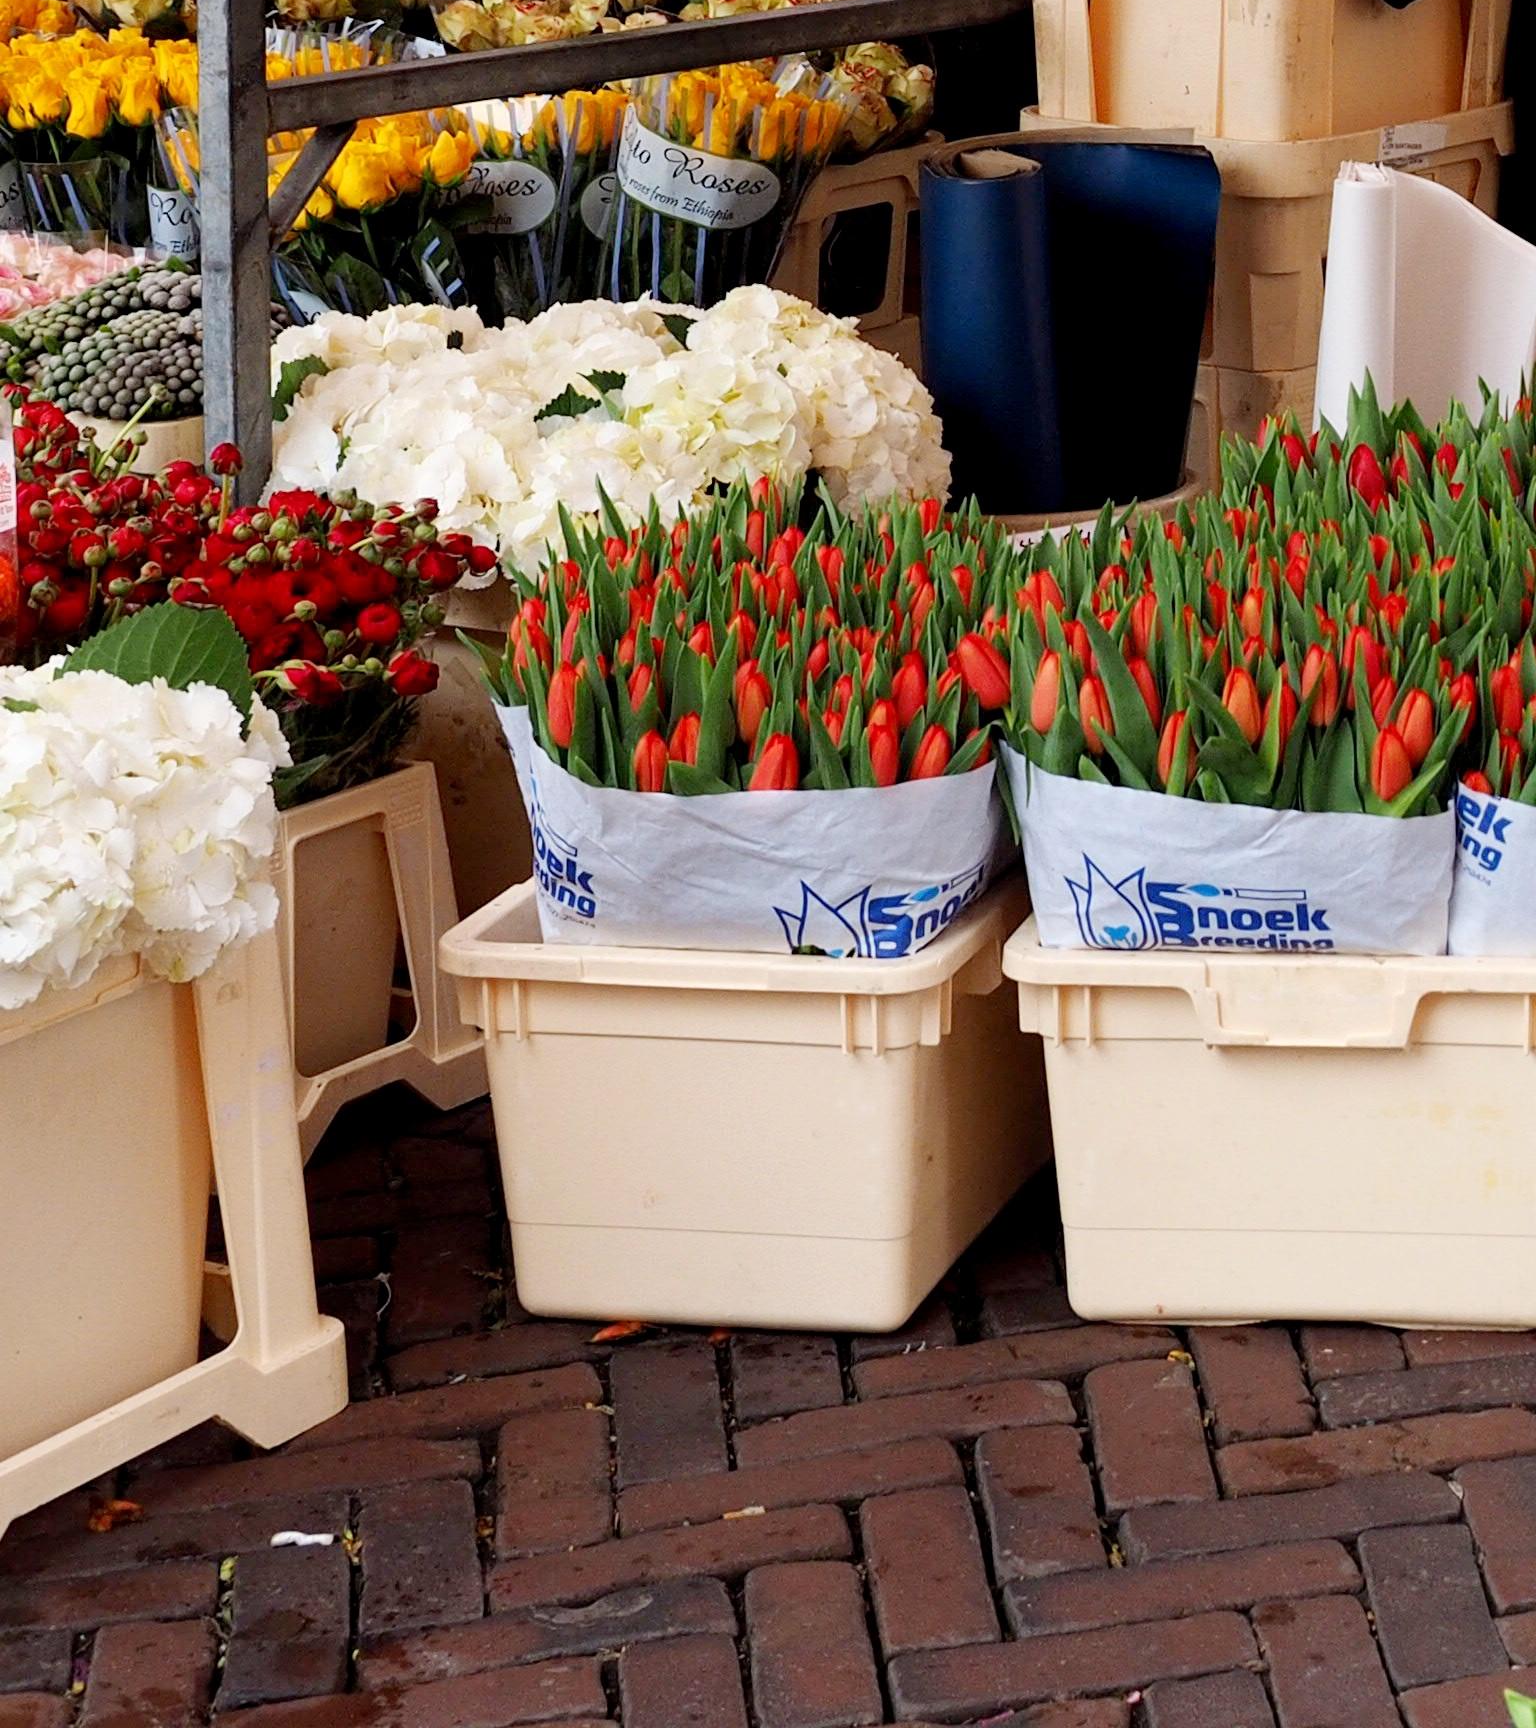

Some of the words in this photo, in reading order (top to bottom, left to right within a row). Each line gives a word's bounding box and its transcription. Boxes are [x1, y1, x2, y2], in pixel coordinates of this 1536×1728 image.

[664, 147, 770, 196] Roses
[682, 196, 735, 226] Ethiopia
[1146, 882, 1333, 932] Snoek
[1160, 924, 1334, 950] Breeding
